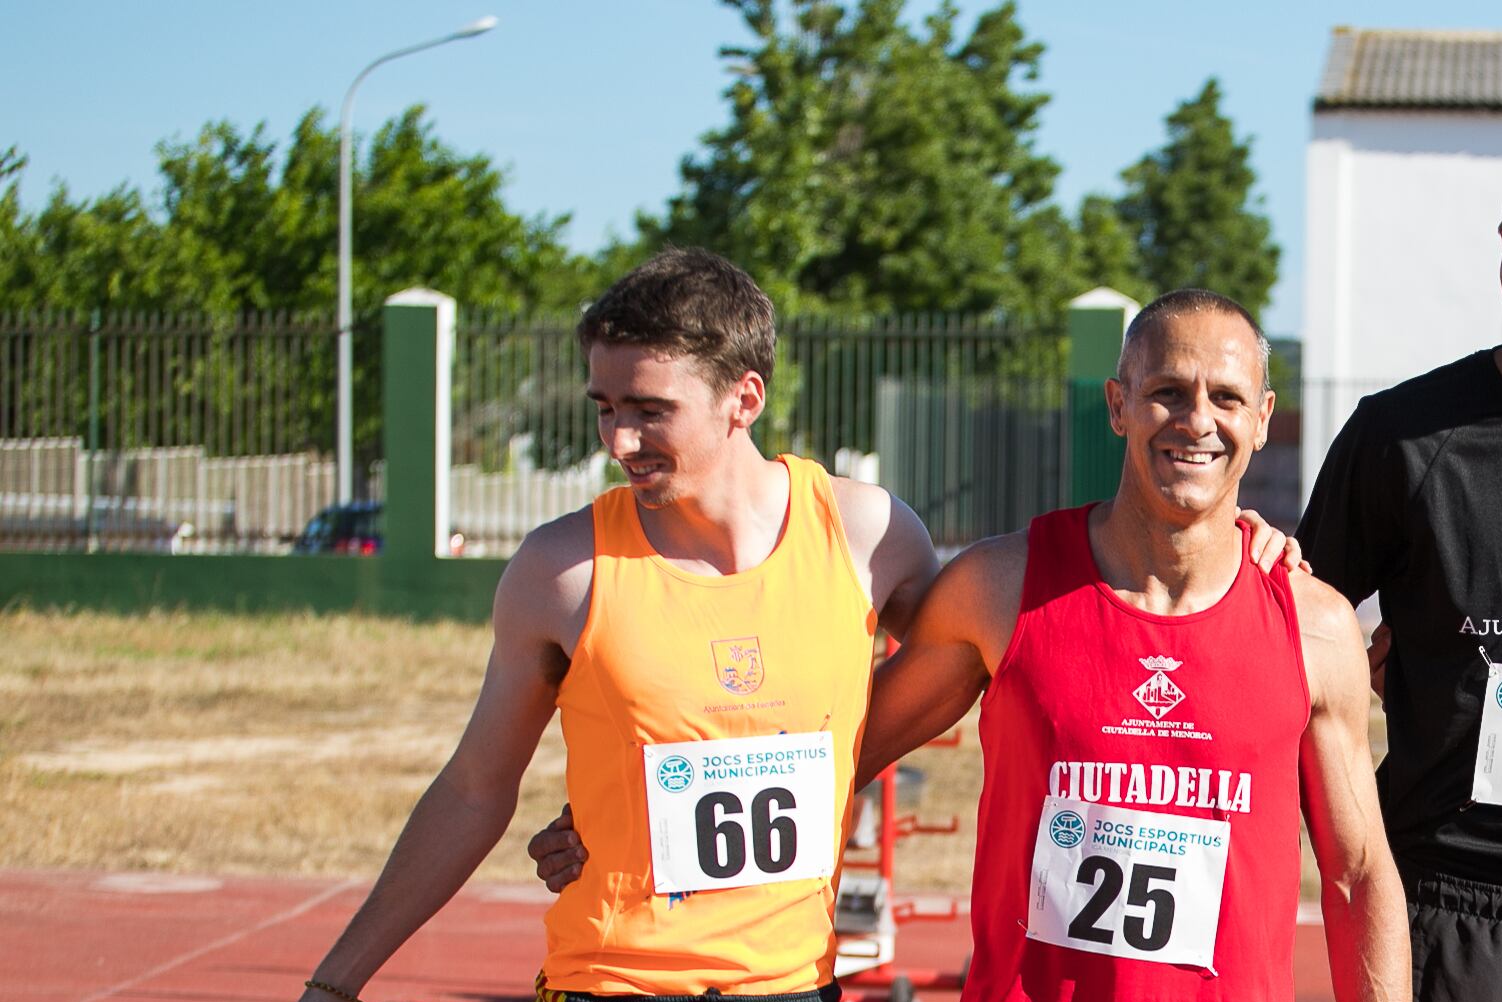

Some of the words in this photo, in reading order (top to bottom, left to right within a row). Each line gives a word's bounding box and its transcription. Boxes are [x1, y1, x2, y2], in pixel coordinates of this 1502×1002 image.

[1101, 726, 1156, 737] CIUTADELLA
[1157, 729, 1169, 737] DE
[1171, 730, 1213, 740] MENORCA
[1121, 718, 1181, 729] AJUNTAMENT
[1183, 721, 1195, 730] DE
[702, 754, 742, 768] JOCS
[747, 747, 827, 764] ESPORTIUS
[704, 763, 796, 780] MUNICIPALS
[1049, 761, 1252, 814] CIUTADELLA
[694, 787, 798, 879] 66
[1093, 833, 1187, 856] MUNICIPALS
[1094, 819, 1134, 836] JOCS
[1139, 827, 1222, 847] ESPORTIUS
[1067, 855, 1177, 951] 25
